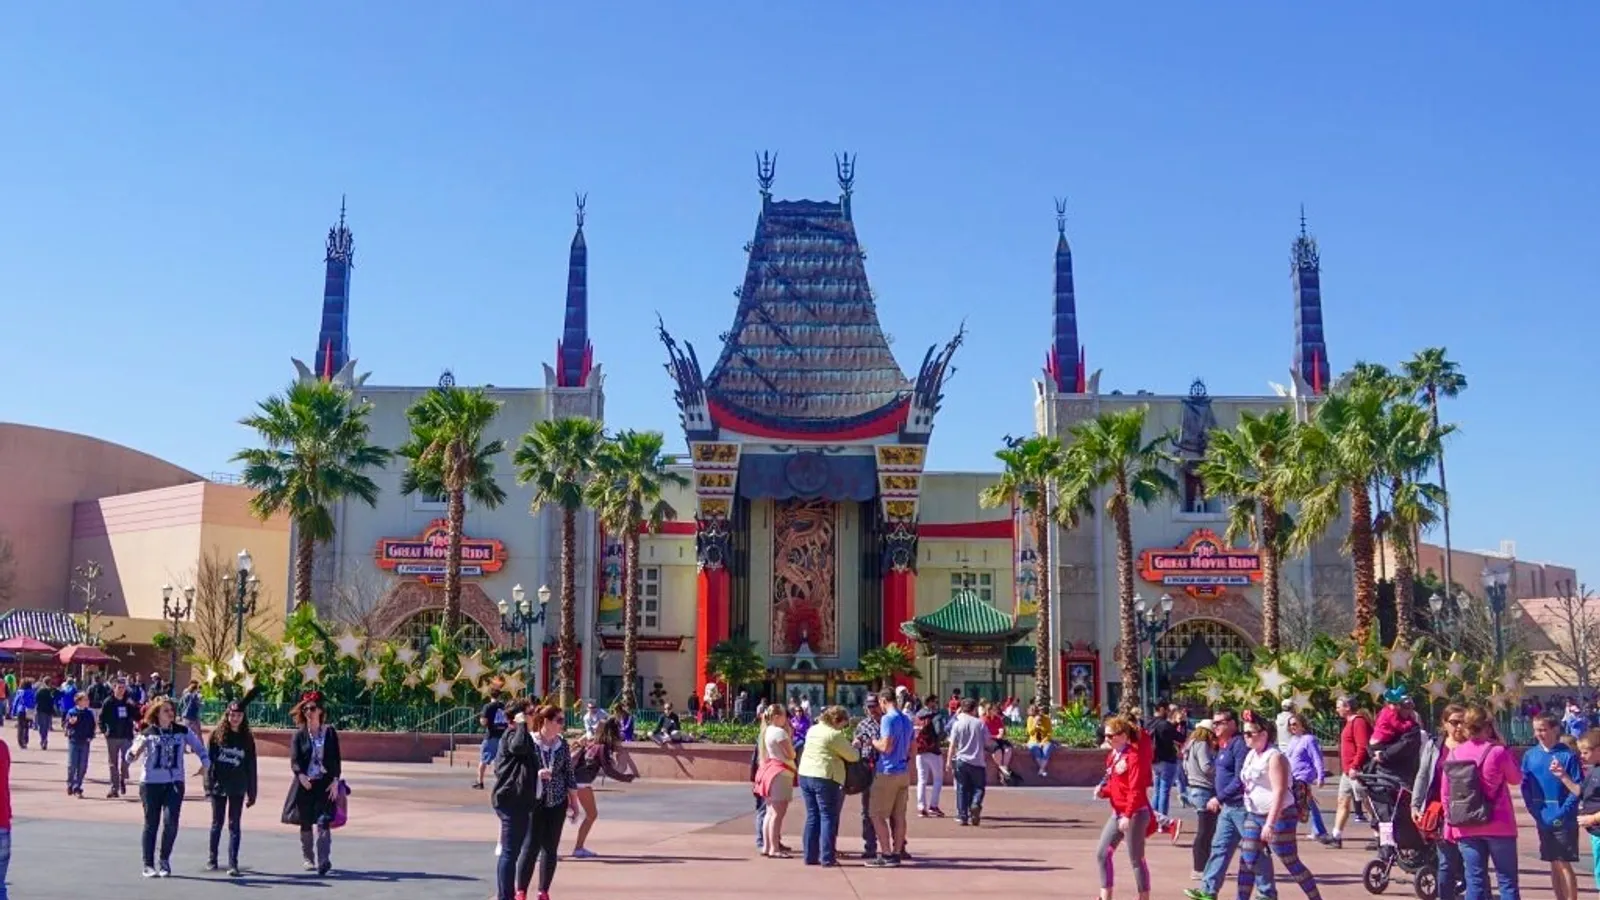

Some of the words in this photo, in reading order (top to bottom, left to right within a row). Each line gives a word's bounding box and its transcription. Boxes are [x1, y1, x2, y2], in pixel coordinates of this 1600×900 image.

[424, 545, 450, 558] MOV
[461, 546, 491, 559] RIDE
[1190, 556, 1228, 569] MOVIE
